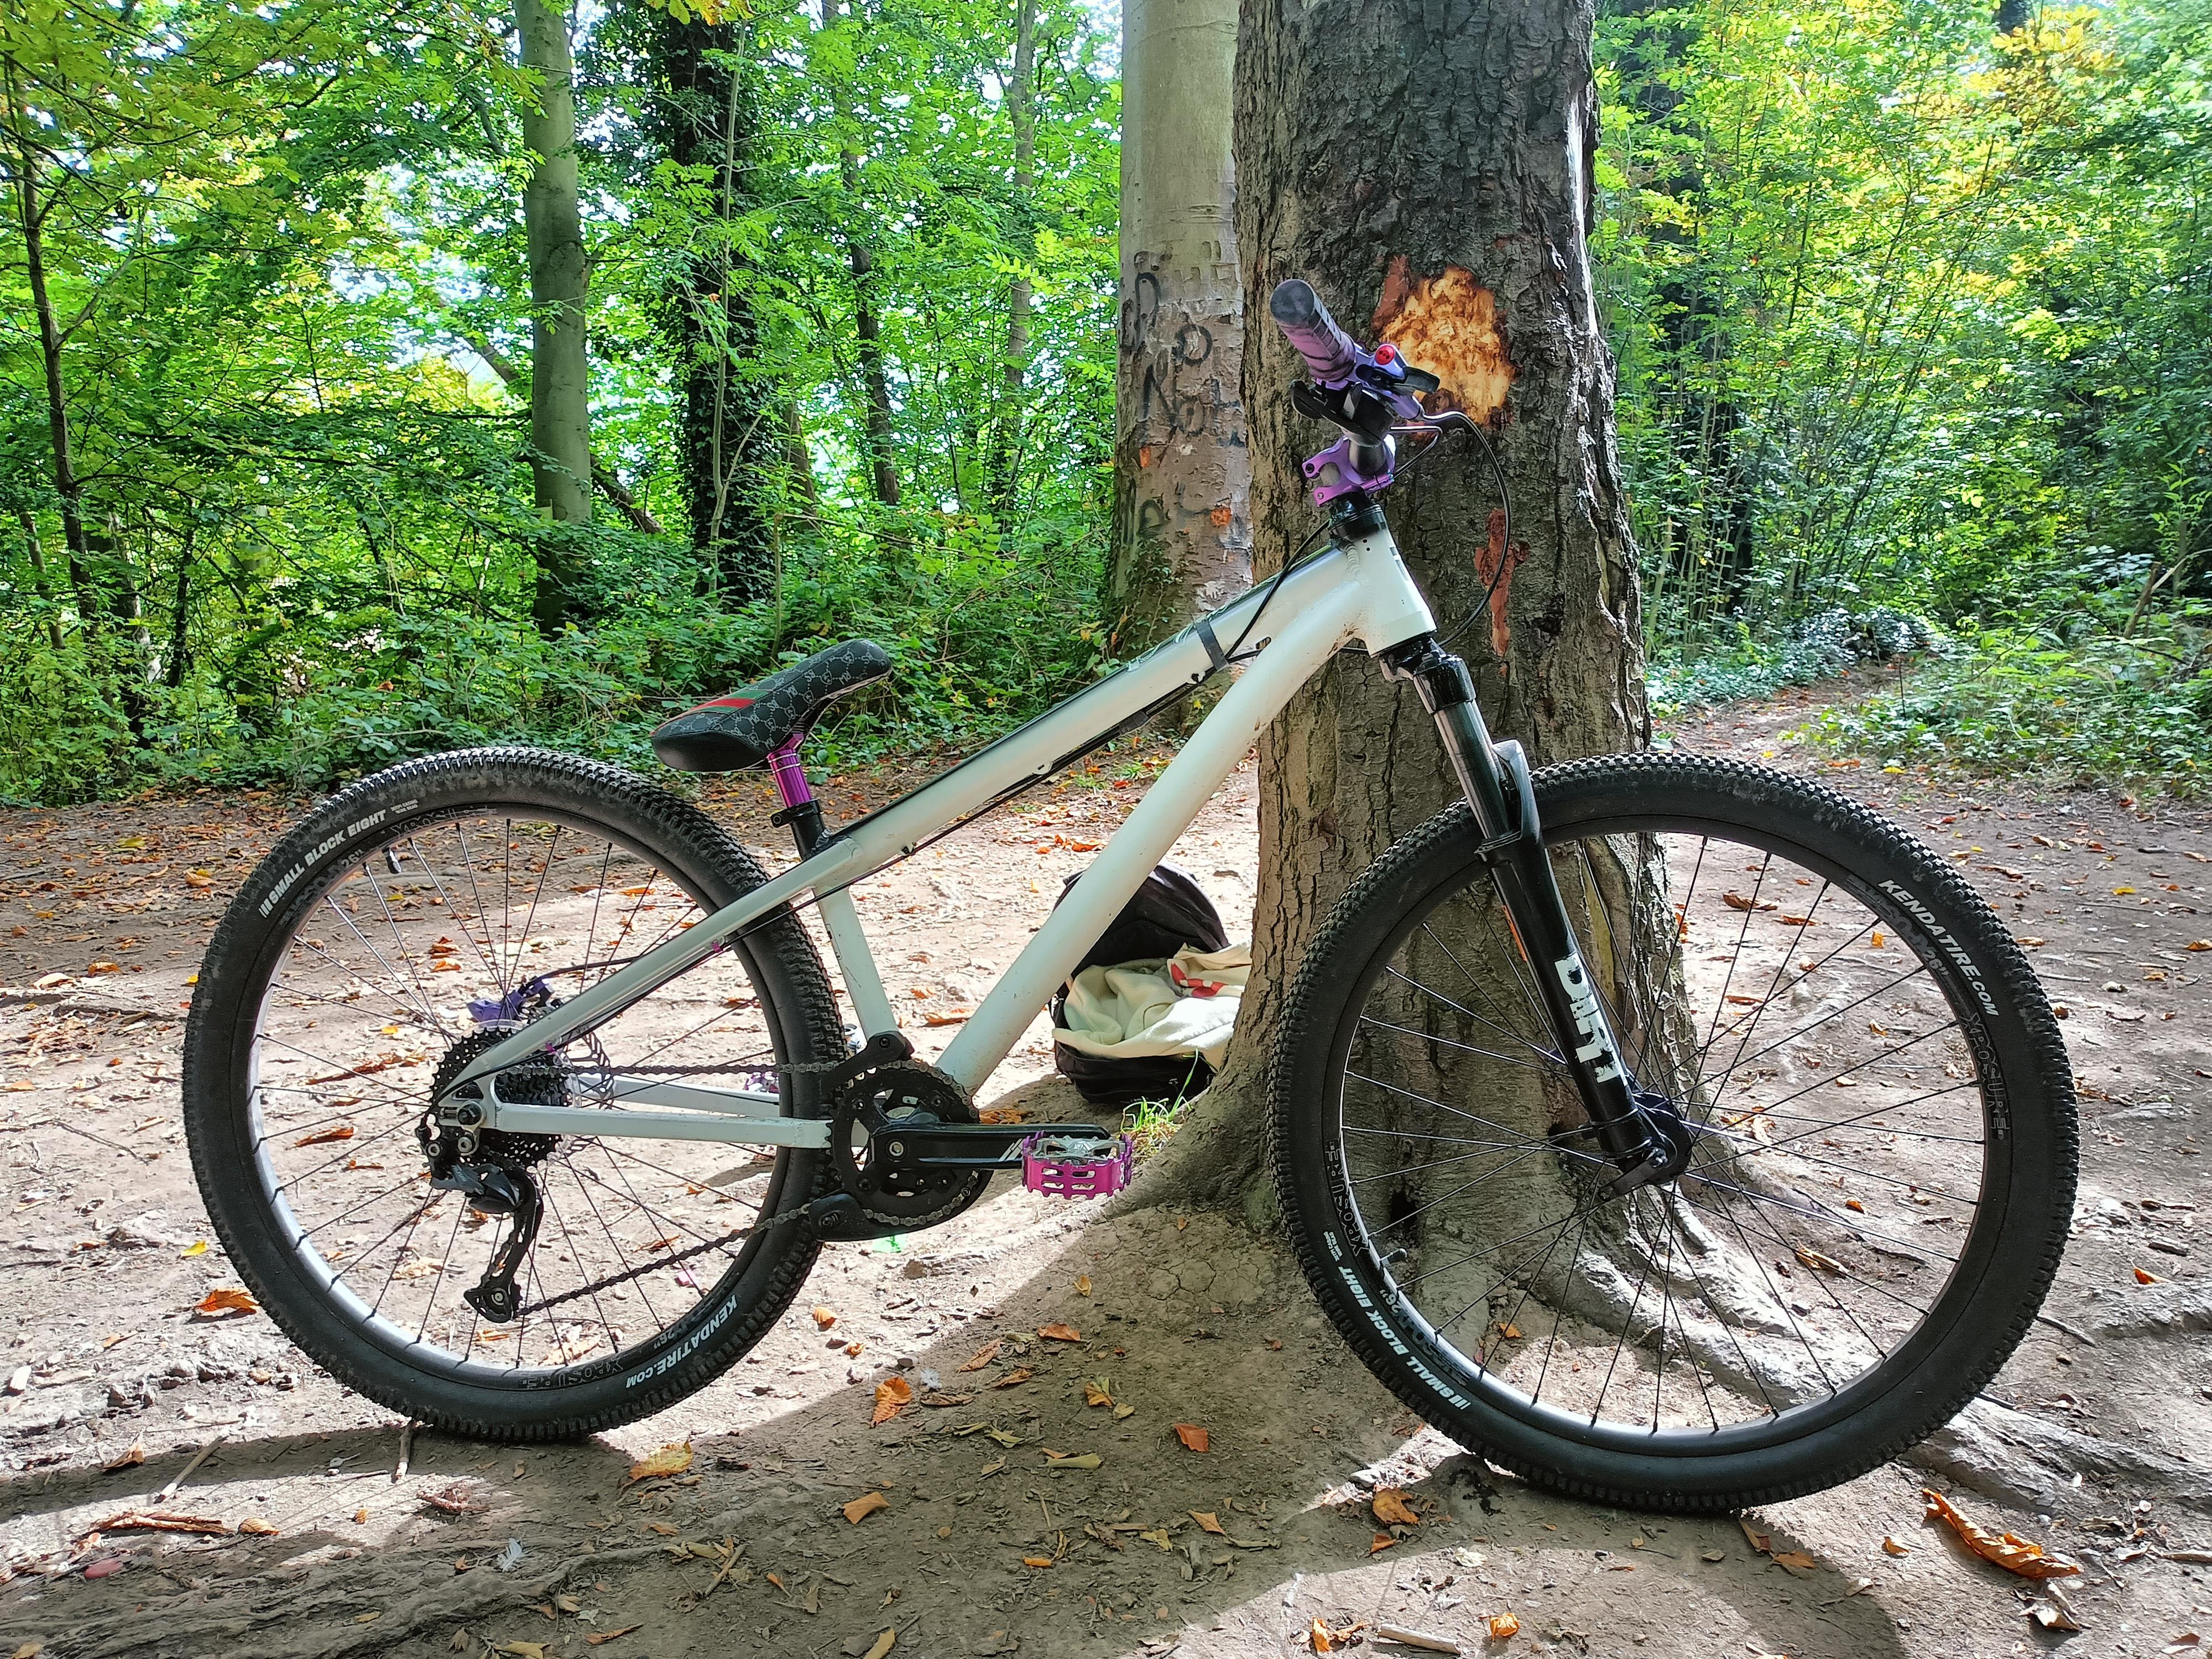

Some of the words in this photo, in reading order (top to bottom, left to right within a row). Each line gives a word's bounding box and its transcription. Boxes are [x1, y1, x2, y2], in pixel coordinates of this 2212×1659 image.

[269, 863, 305, 905] SMALL
[305, 830, 347, 867] BLOCK
[347, 809, 387, 837] EIGHT
[1878, 880, 2000, 1016] KENDATIRE.COM
[1338, 1266, 1374, 1308] EIGHT
[626, 1295, 738, 1389] KENDATIRE.COM
[1365, 1309, 1409, 1355] BLOCK
[1406, 1356, 1455, 1399] SMALL
